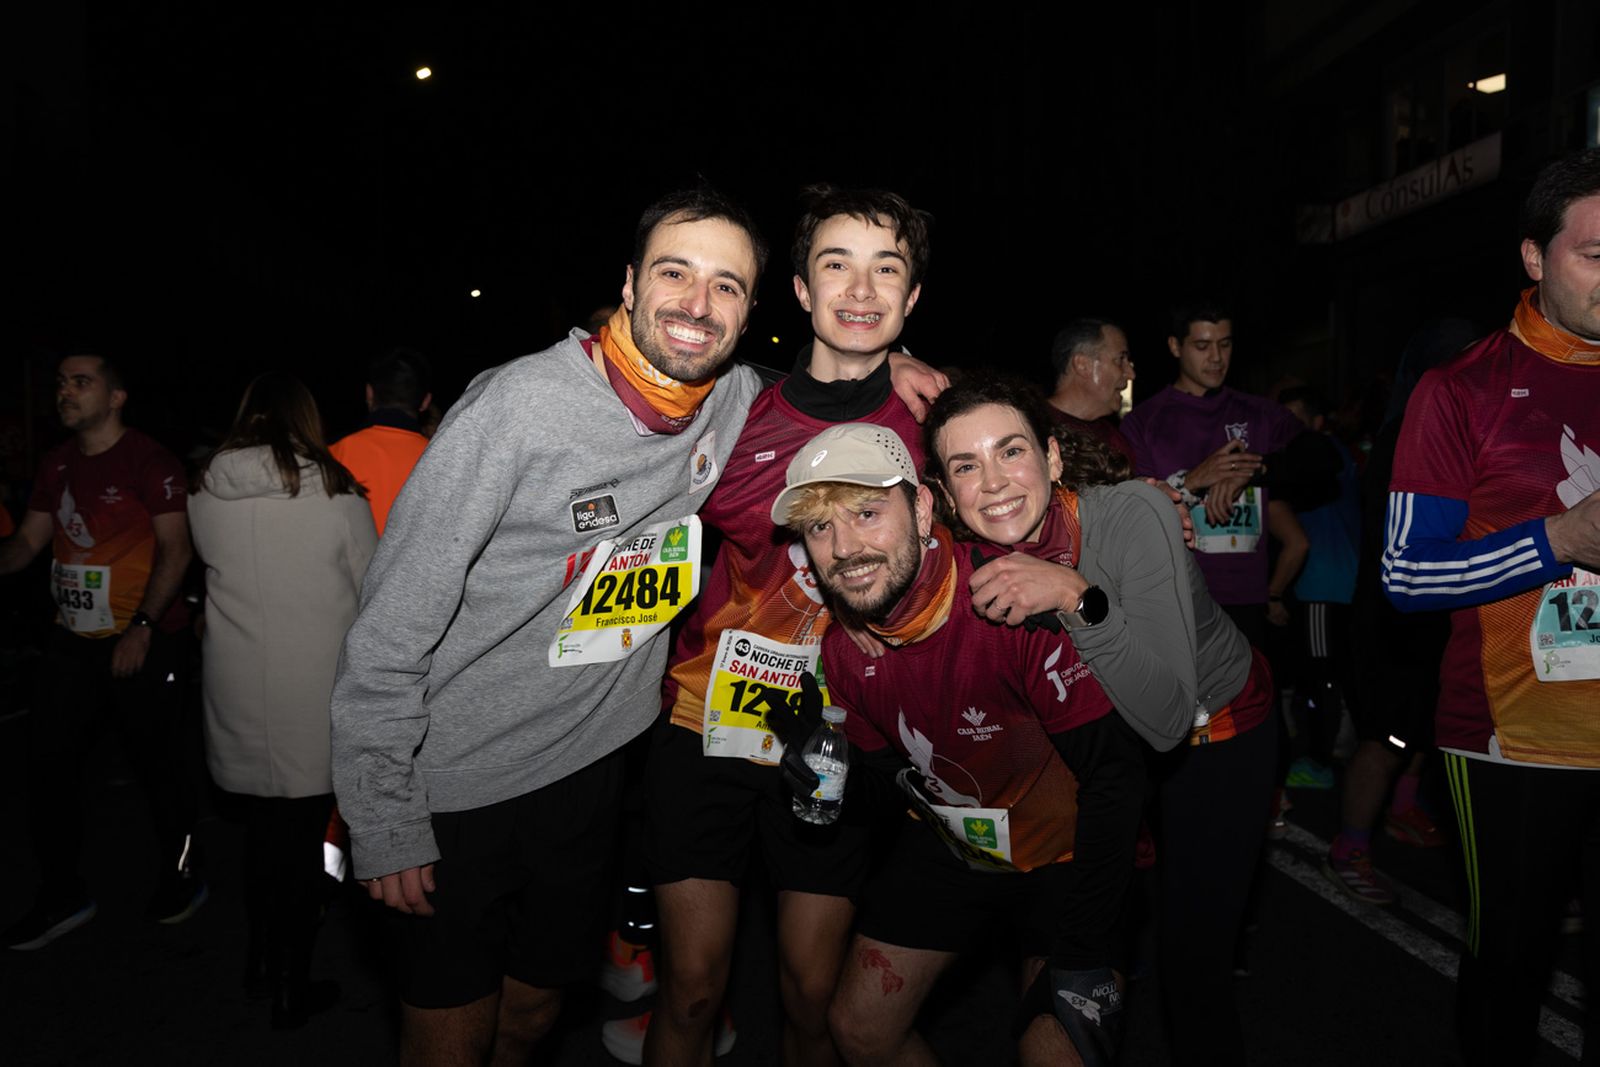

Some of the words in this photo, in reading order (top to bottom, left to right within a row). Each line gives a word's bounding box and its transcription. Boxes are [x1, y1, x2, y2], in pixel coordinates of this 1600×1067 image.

[576, 511, 595, 521] liga
[578, 514, 617, 529] endesa
[640, 538, 657, 550] DE
[608, 551, 651, 570] ANTÓN
[580, 566, 681, 616] 12484
[596, 615, 636, 628] Francisco
[638, 613, 658, 623] José
[735, 641, 750, 653] 43
[749, 650, 792, 670] NOCHE
[794, 659, 809, 672] DE
[729, 659, 759, 679] SAN
